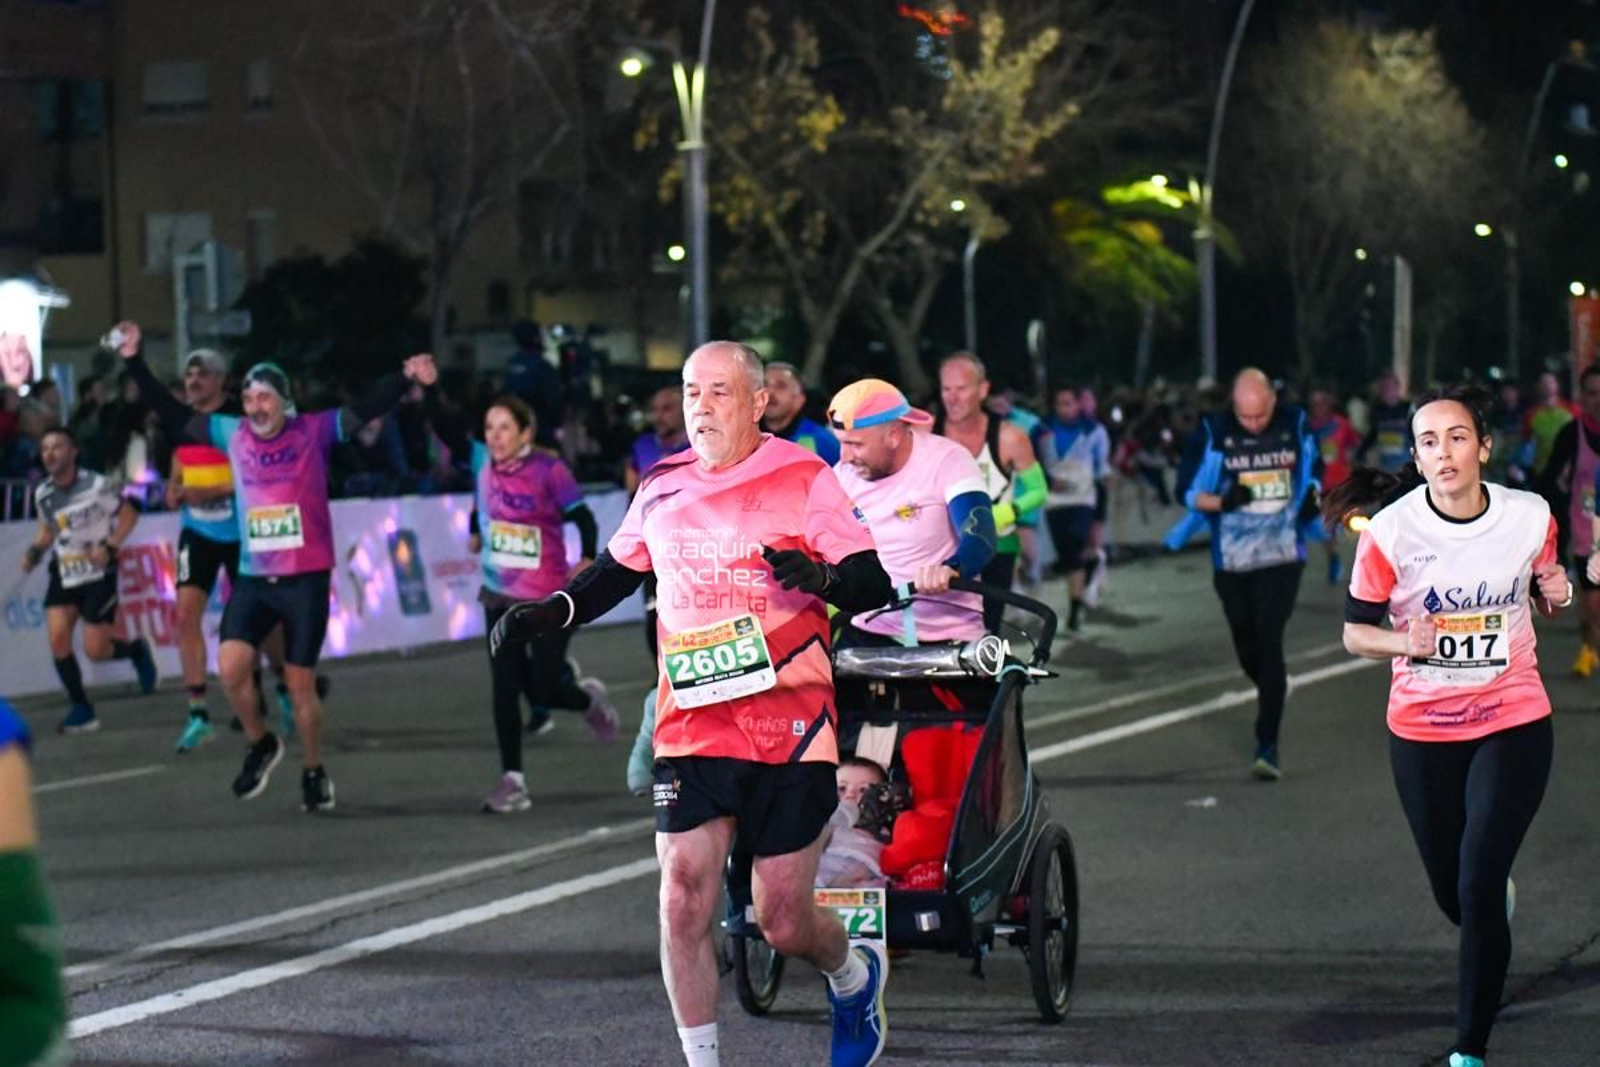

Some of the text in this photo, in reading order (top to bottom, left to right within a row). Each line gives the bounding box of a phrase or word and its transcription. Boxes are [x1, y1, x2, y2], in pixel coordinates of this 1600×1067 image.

[1445, 576, 1520, 612] Salud
[671, 638, 760, 682] 2605
[1438, 633, 1499, 660] 017
[836, 907, 877, 933] 72
